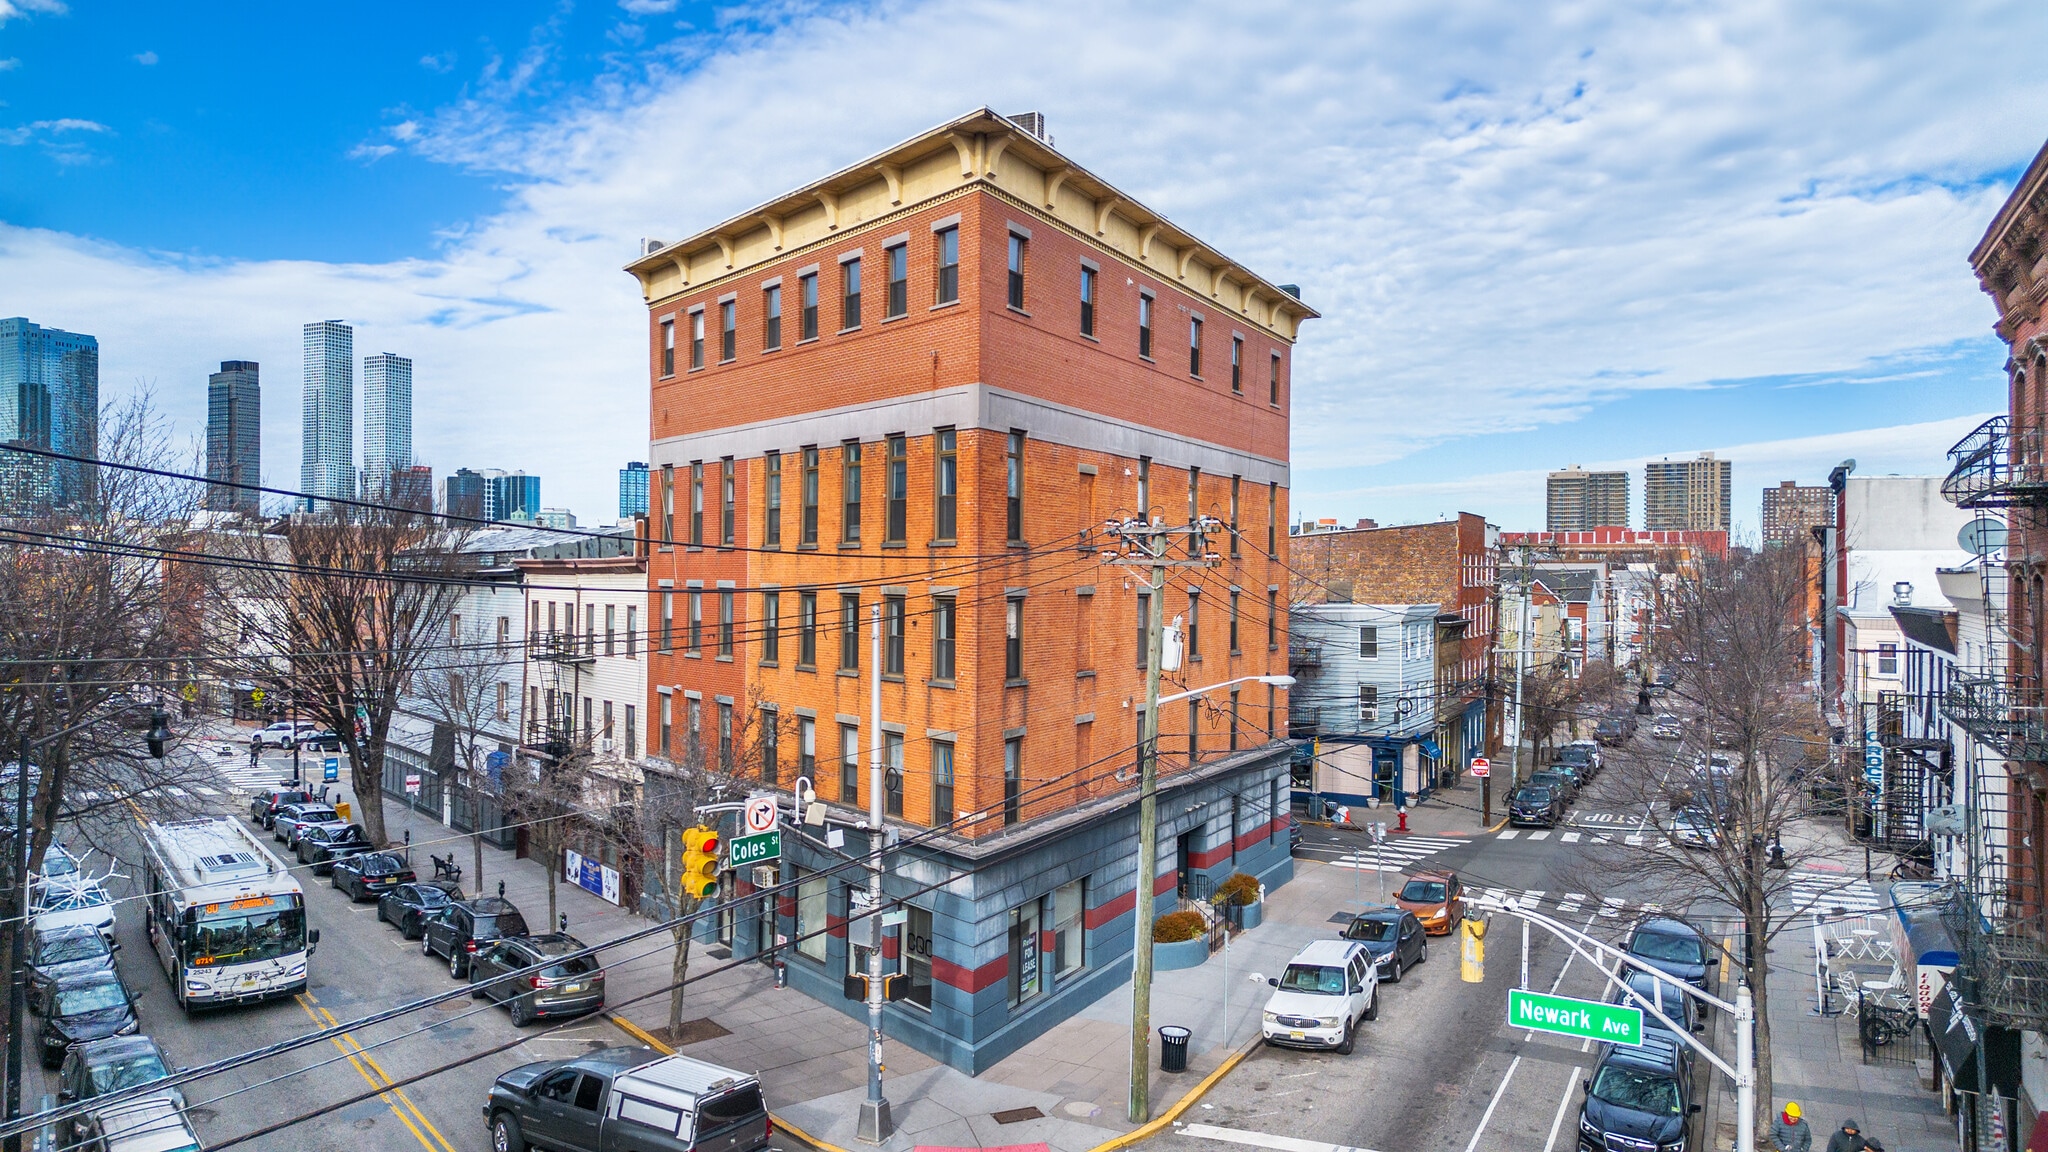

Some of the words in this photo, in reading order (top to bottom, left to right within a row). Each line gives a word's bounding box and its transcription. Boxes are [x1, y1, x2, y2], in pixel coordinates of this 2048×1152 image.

[1585, 813, 1641, 824] STOP
[732, 841, 766, 861] Coles
[771, 836, 778, 845] St
[1024, 946, 1034, 959] FOR
[195, 956, 214, 966] 0714
[1022, 958, 1036, 974] LEASE
[193, 968, 212, 976] 25243
[1919, 972, 1931, 1014] LIQUORS
[1520, 999, 1591, 1029] Newark
[1602, 1017, 1630, 1035] Ave
